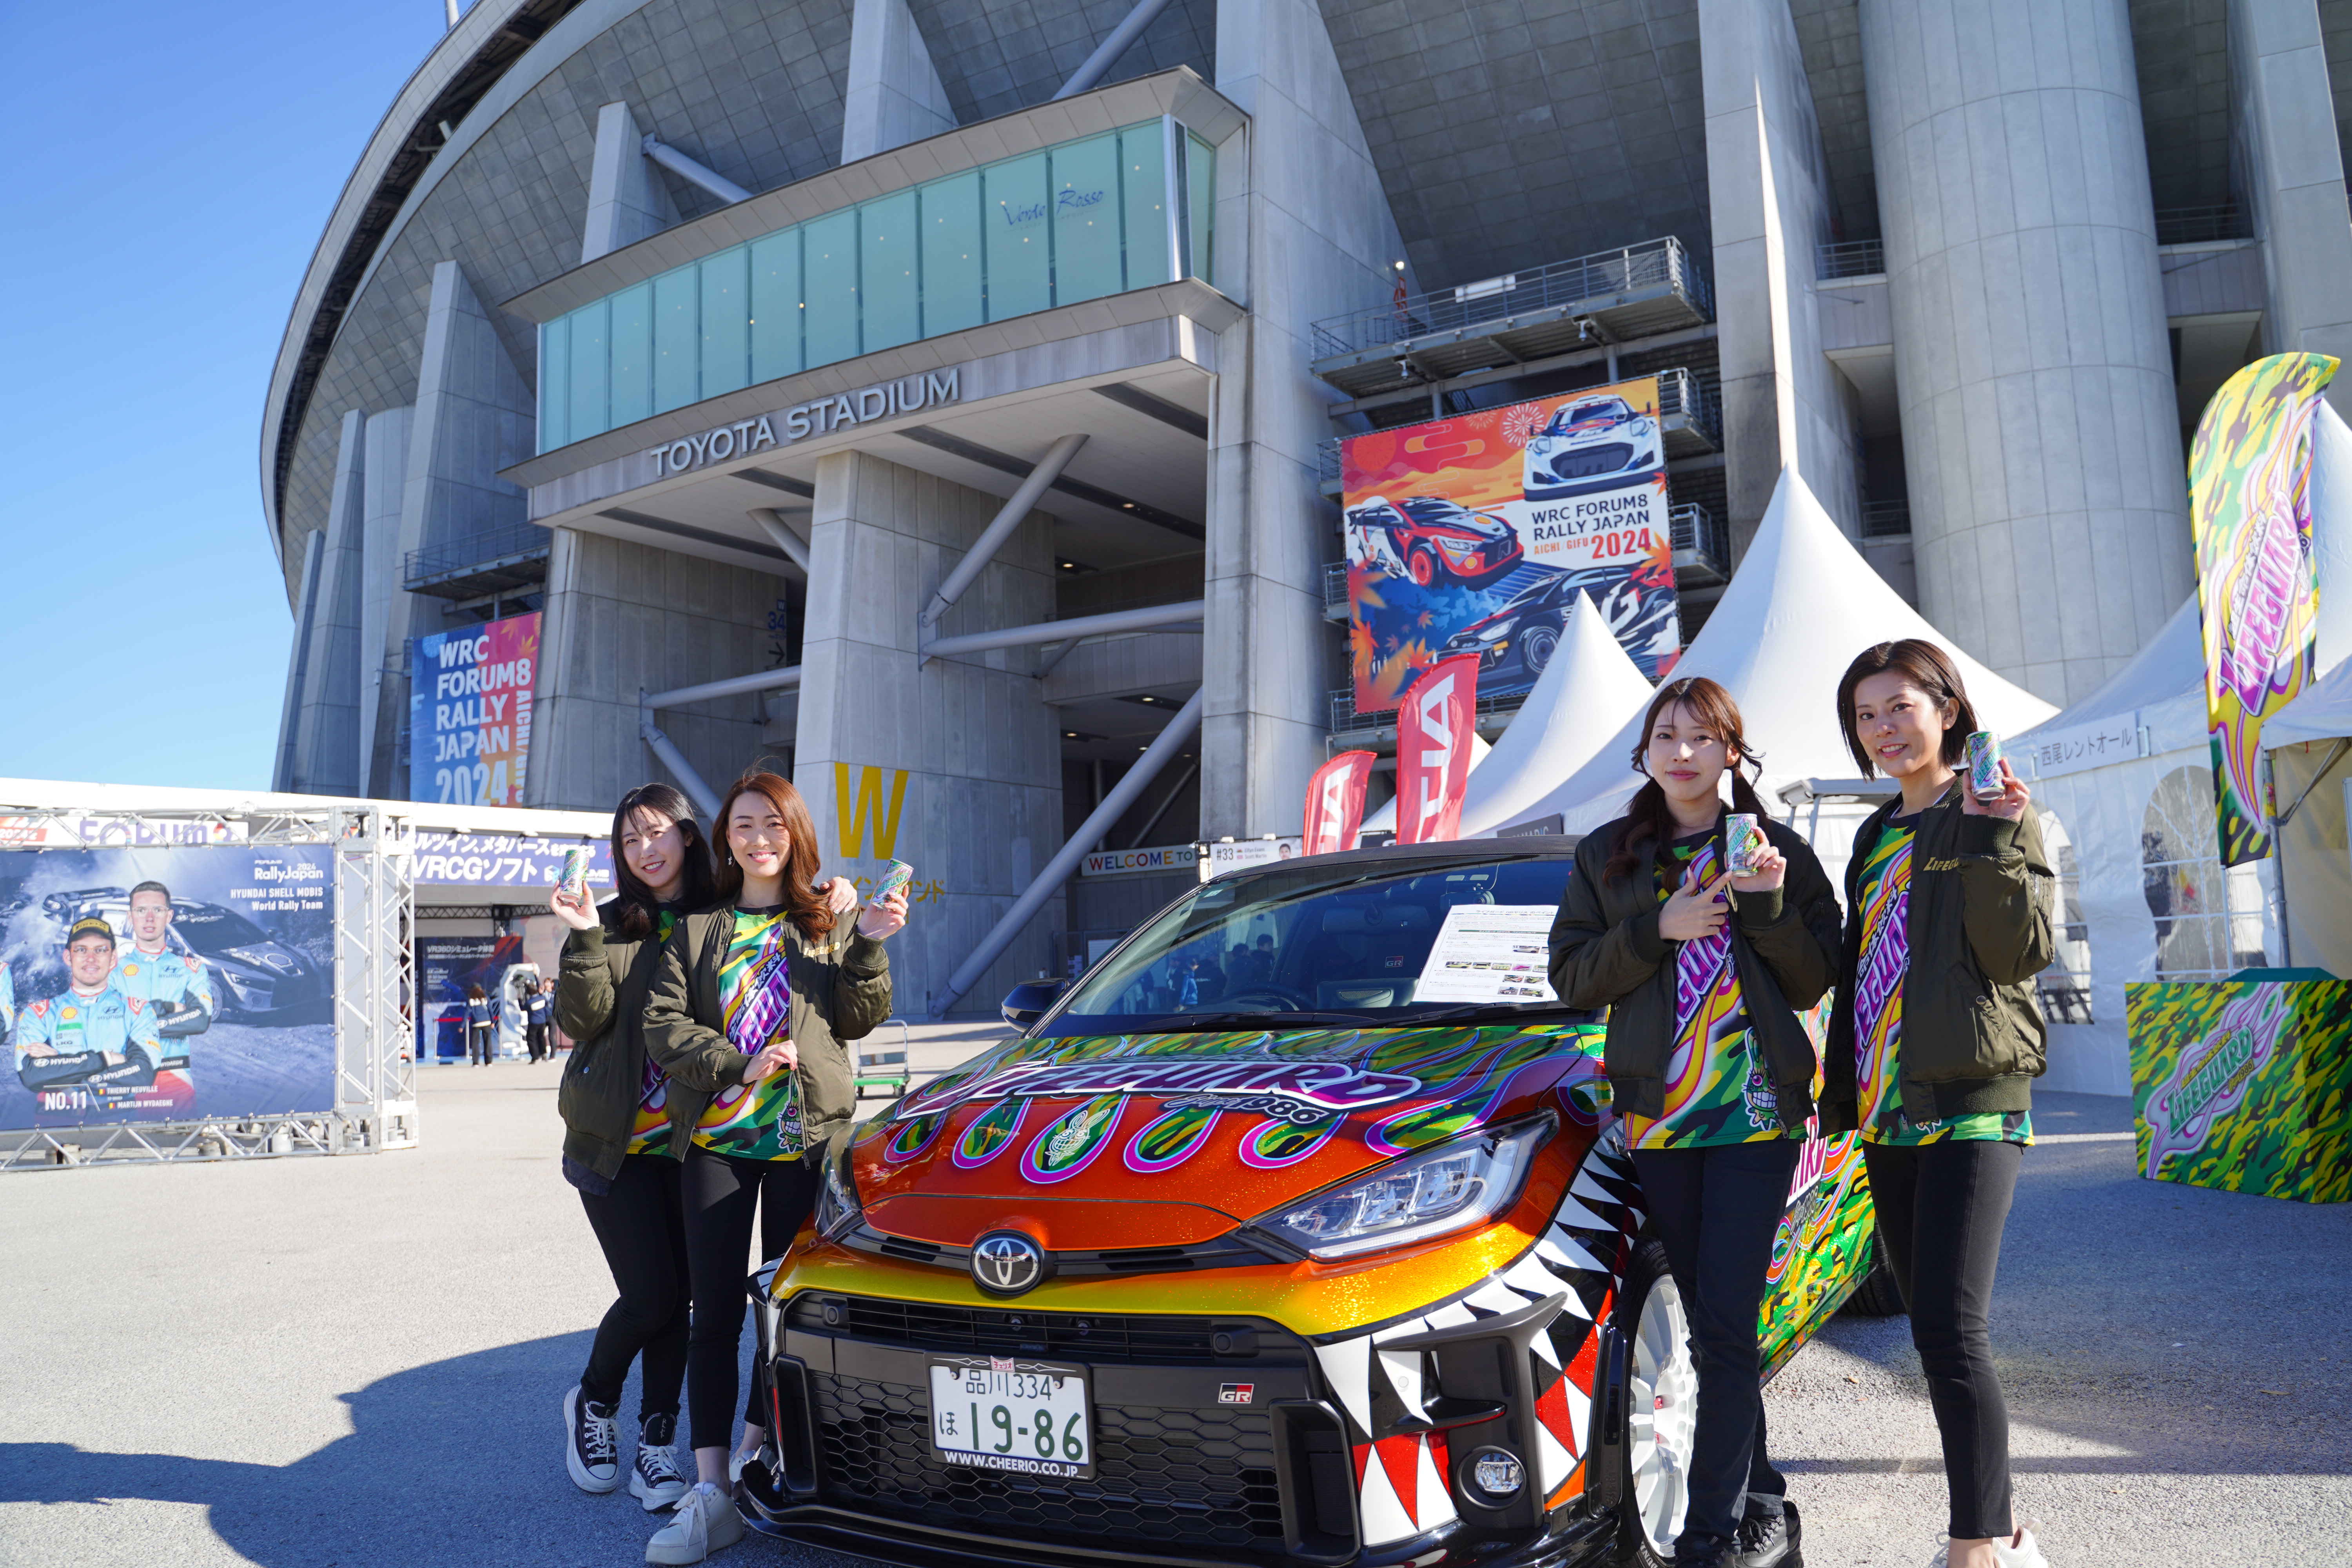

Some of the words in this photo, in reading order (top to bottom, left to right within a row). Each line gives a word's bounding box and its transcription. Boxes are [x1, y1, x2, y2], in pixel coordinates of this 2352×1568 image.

[1056, 190, 1104, 216] Rosso
[650, 417, 777, 477] TOYOTA
[787, 368, 959, 439] STADIUM
[1532, 507, 1570, 524] WRC
[1576, 494, 1648, 517] FORUM8
[1534, 520, 1587, 541] RALLY
[1593, 510, 1650, 531] JAPAN
[1591, 528, 1651, 559] 2024
[768, 611, 786, 632] 34
[439, 634, 490, 669] WRC
[436, 658, 532, 700] FORUM8
[436, 694, 509, 731] RALLY
[435, 725, 510, 763] JAPAN
[2040, 728, 2132, 766] 西尾レントオール
[436, 760, 509, 807] 2024
[834, 762, 909, 860] W
[1089, 850, 1174, 871] WELCOME
[1177, 851, 1192, 862] TO
[1217, 848, 1233, 860] #33
[1923, 857, 1959, 871] LIFEGU
[230, 888, 267, 899] HYUNDAI
[269, 887, 294, 898] SHELL
[297, 887, 323, 897] MOBIS
[252, 901, 276, 911] World
[278, 900, 299, 912] Rally
[301, 899, 323, 909] Team
[50, 1053, 88, 1065] HYUNDAI
[102, 1064, 141, 1081] HYUNDAI
[2165, 1025, 2254, 1138] LIFEGUARD
[44, 1091, 87, 1111] NO.11
[131, 1085, 158, 1093] NEUVILLE
[118, 1100, 142, 1109] MARTIJN
[143, 1099, 173, 1107] WYDAEGHE
[994, 1360, 1012, 1370] チェリオ
[1220, 1391, 1250, 1402] GR
[940, 1412, 958, 1436] ほ
[971, 1402, 1083, 1461] 19-86
[944, 1451, 1078, 1477] WWW.CHEERIO.CO.JP
